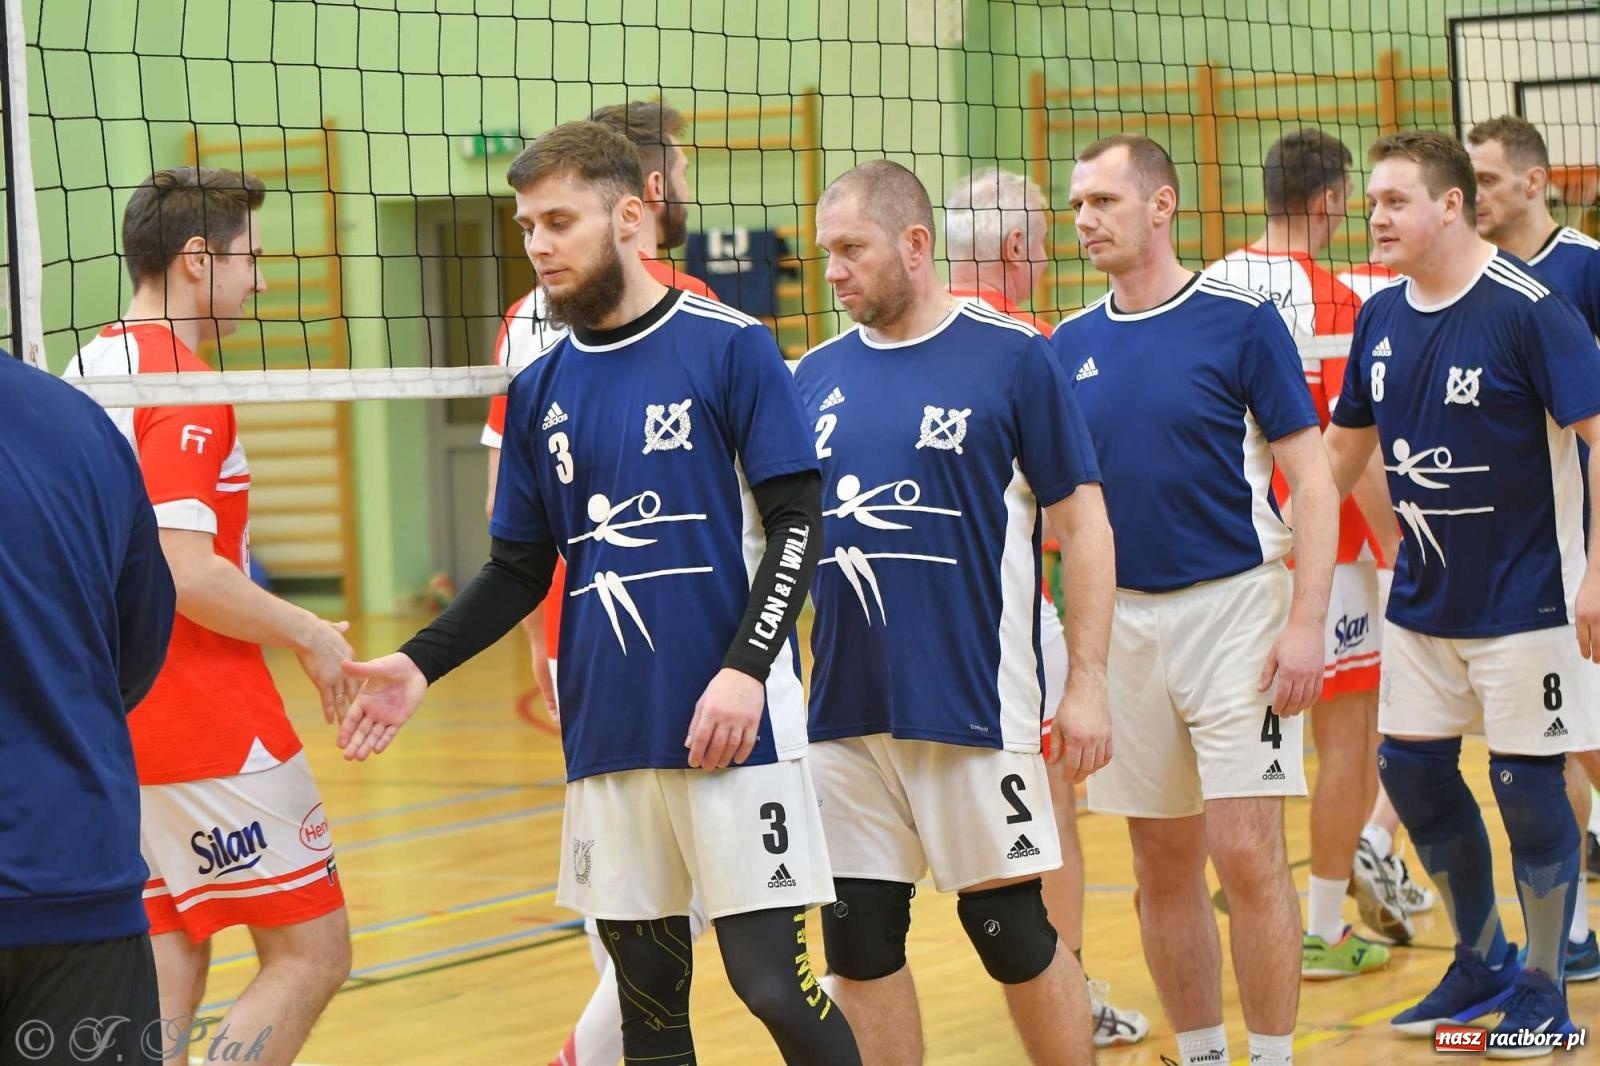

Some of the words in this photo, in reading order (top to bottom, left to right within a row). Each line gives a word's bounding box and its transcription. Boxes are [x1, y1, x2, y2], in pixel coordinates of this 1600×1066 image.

[1371, 361, 1386, 403] 8
[548, 431, 574, 485] 3
[814, 413, 838, 460] 2
[780, 525, 810, 570] WILL
[774, 582, 792, 597] &
[754, 595, 788, 640] CAN
[1543, 672, 1563, 711] 8
[1261, 705, 1282, 749] 4
[191, 820, 269, 876] Silan
[760, 802, 789, 855] 3
[1006, 847, 1041, 860] adidas
[767, 878, 797, 888] adidas
